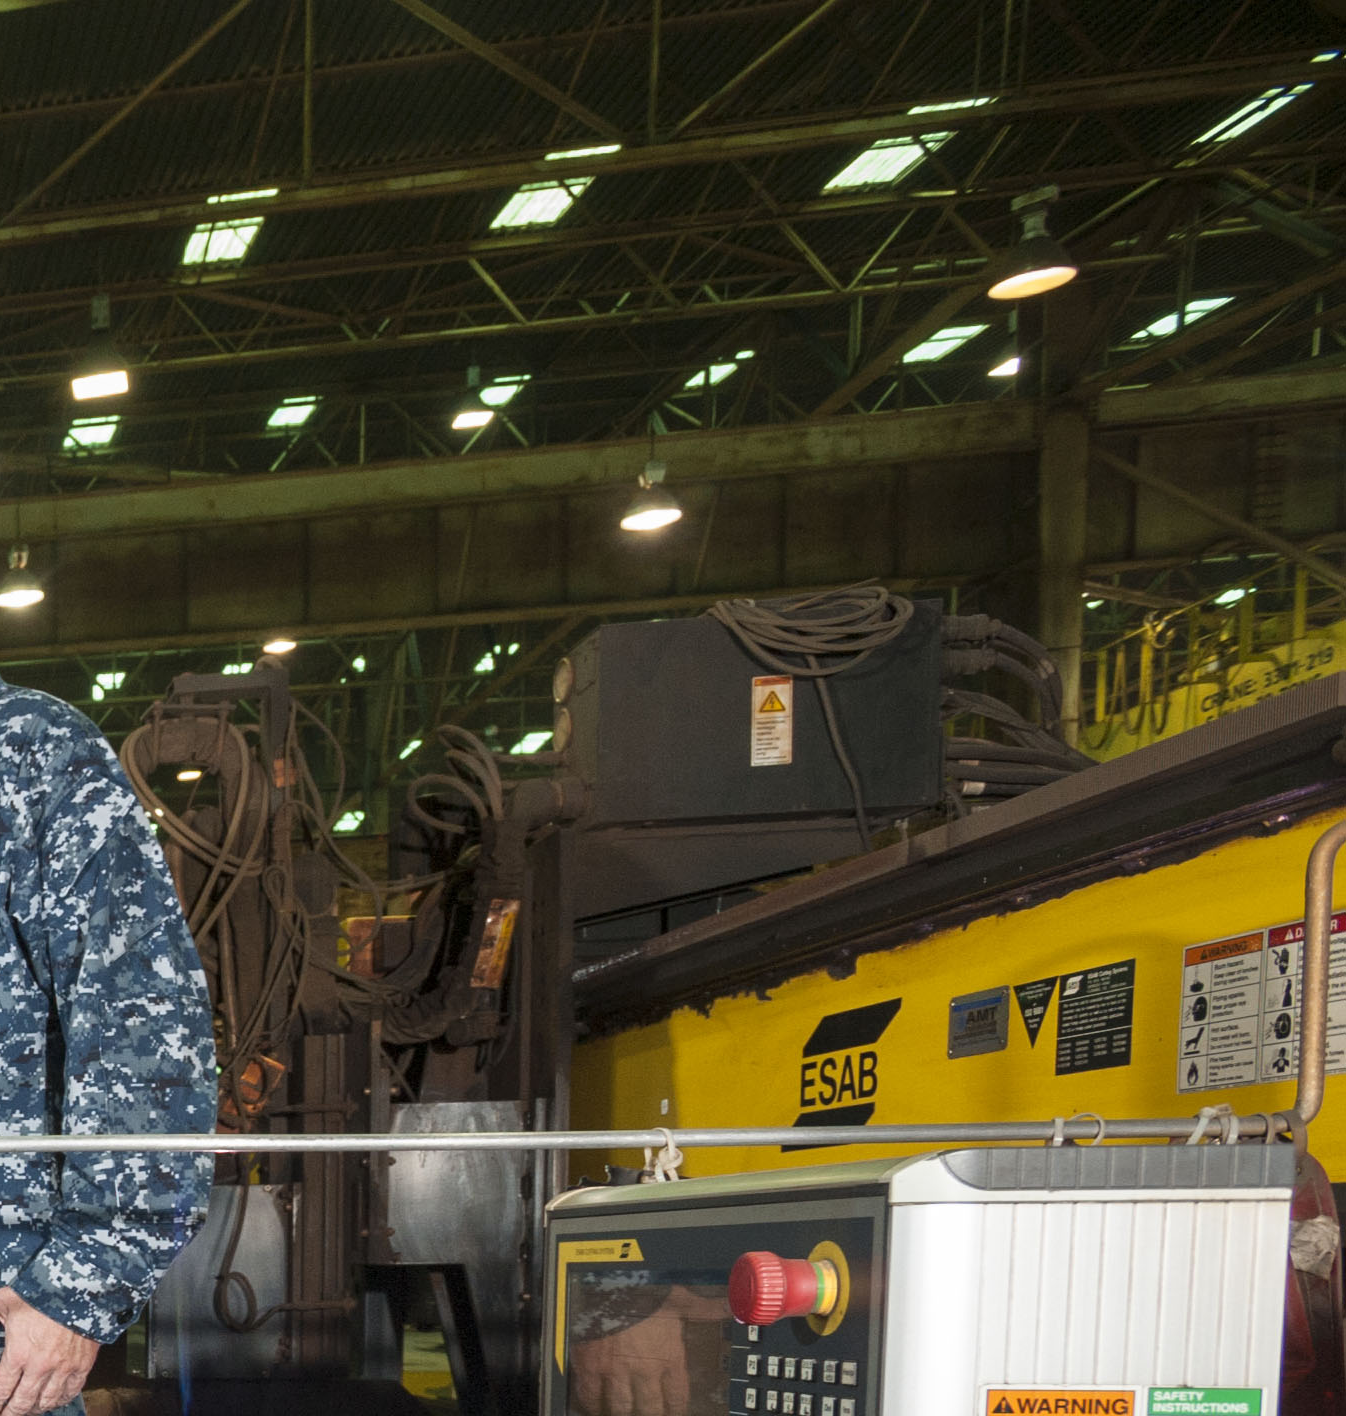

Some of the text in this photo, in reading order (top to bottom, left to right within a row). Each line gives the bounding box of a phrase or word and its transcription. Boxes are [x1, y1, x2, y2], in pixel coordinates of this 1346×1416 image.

[1208, 941, 1249, 957] WARNING
[966, 1006, 997, 1022] AMT
[800, 1051, 879, 1108] ESAB
[1153, 1391, 1205, 1402] SAFETY
[1016, 1397, 1130, 1415] WARNING
[1152, 1402, 1249, 1413] INSTRUCTIONS
